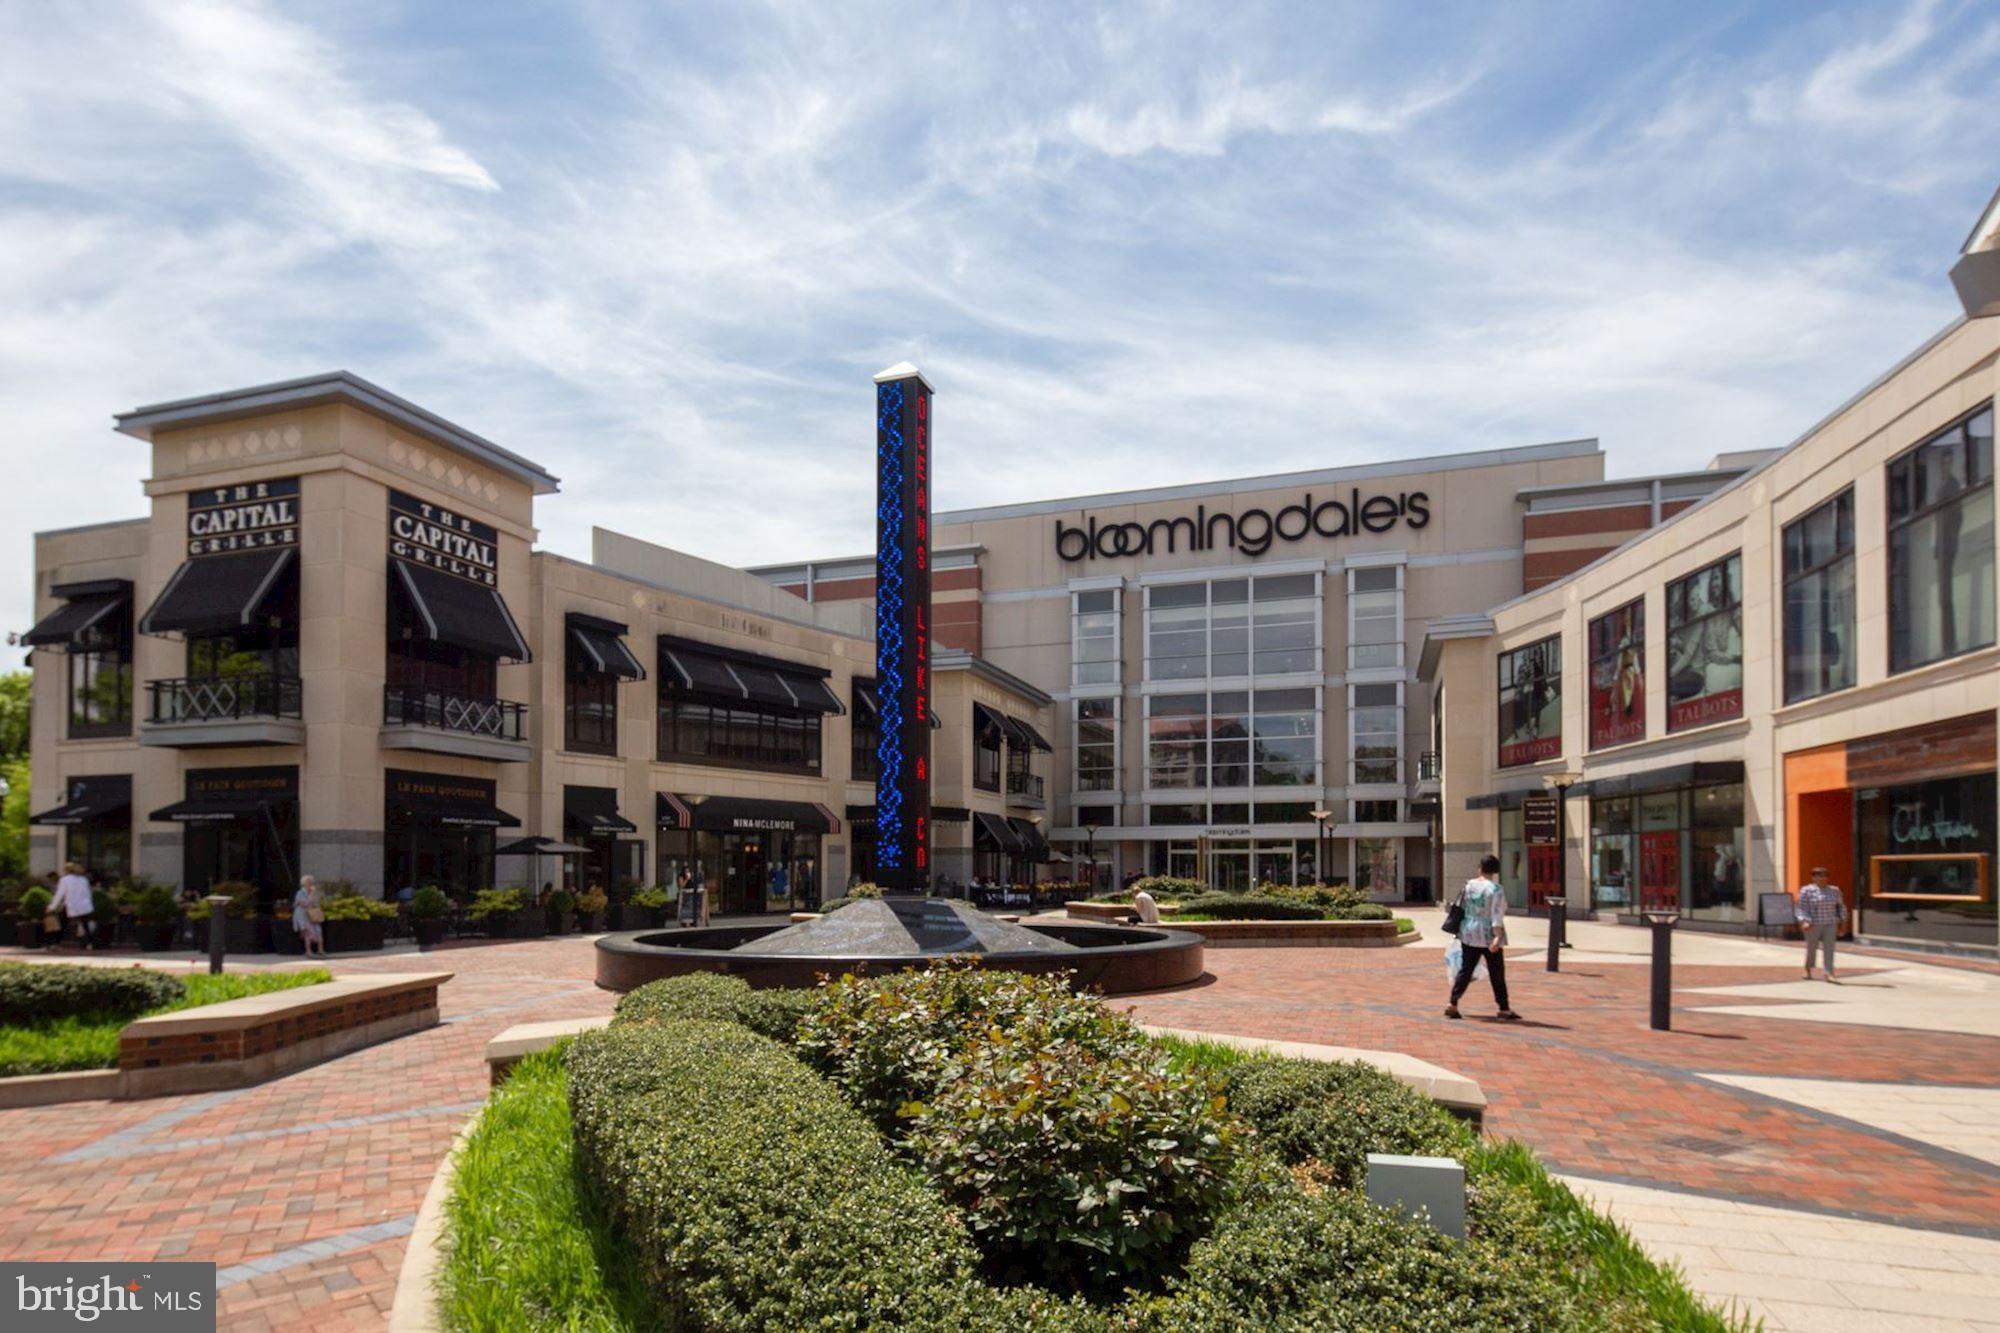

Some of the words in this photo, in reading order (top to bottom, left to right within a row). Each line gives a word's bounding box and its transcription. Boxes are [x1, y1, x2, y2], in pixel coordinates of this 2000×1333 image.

[214, 483, 269, 503] THE
[191, 502, 294, 535] CAPITAL
[421, 504, 472, 533] THE
[1056, 488, 1430, 563] bloomingdale's
[393, 516, 494, 568] CAPITAL
[916, 604, 927, 720] LIKE
[1677, 695, 1739, 723] TALBOTS
[917, 756, 926, 781] A
[733, 818, 754, 828] NINA
